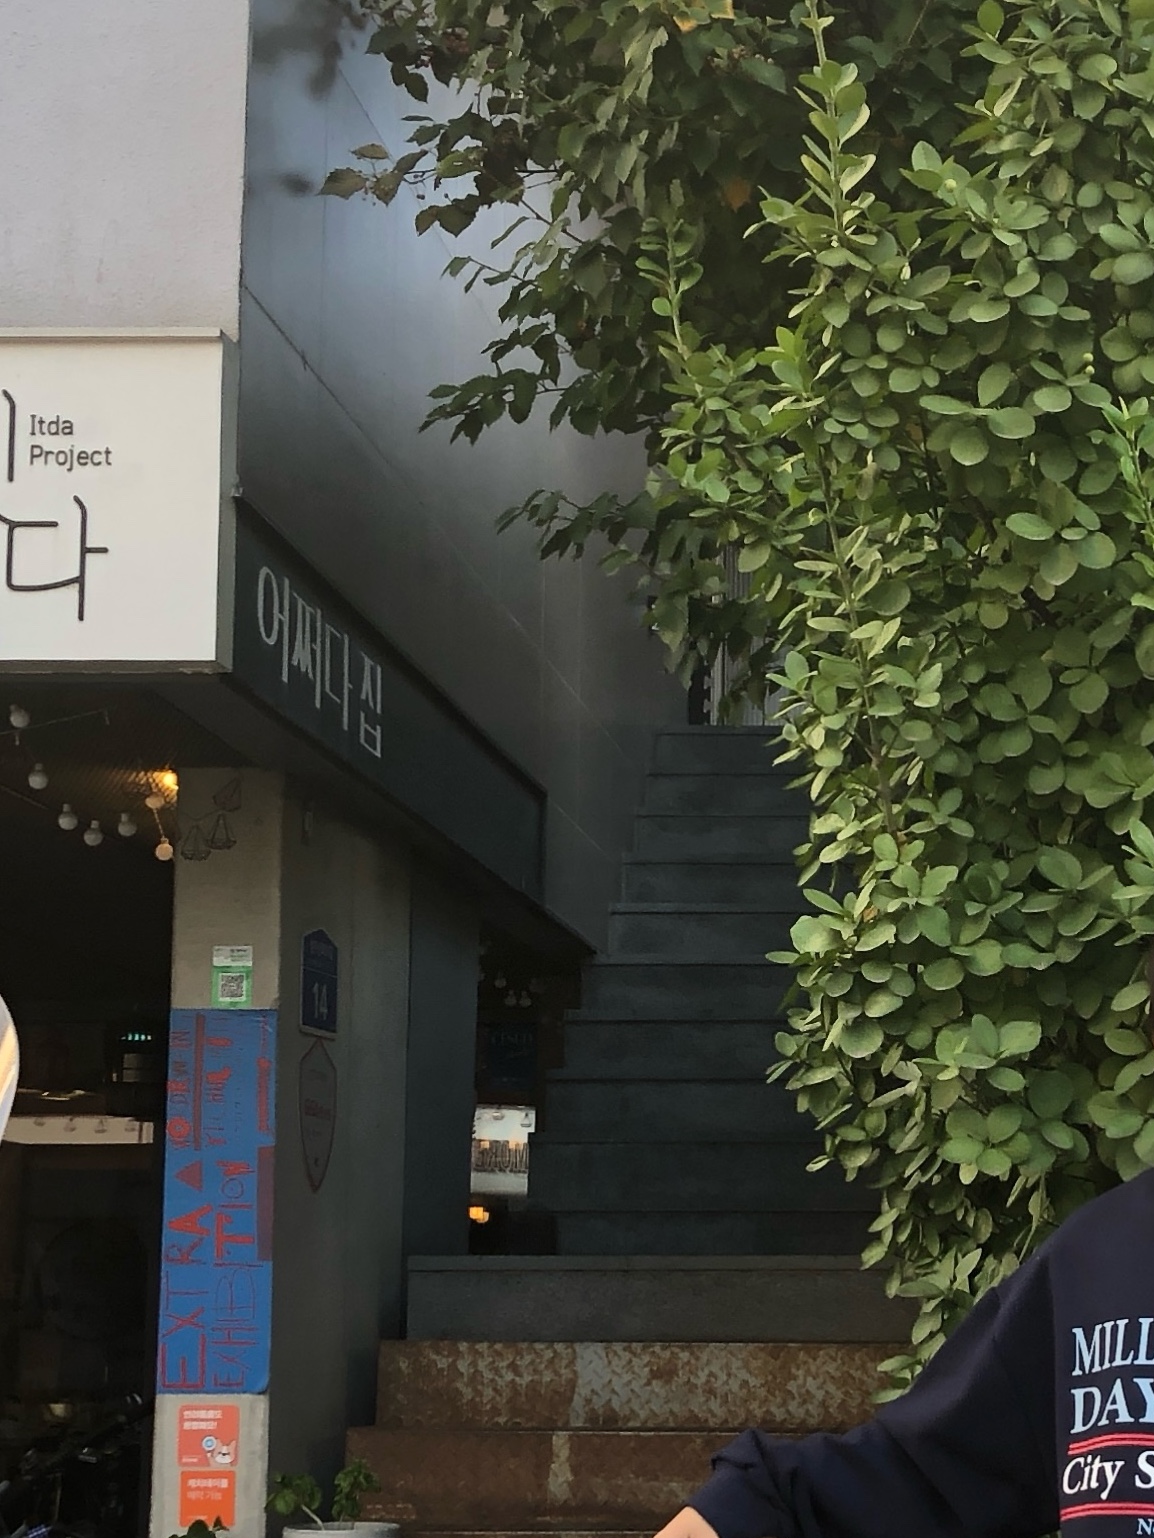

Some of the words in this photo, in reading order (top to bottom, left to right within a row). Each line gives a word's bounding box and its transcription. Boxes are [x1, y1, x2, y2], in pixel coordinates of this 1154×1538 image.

[29, 414, 74, 436] Itda
[29, 444, 112, 472] Project
[312, 981, 328, 1021] 14
[161, 1204, 214, 1389] EXTRA
[1062, 1454, 1124, 1500] City
